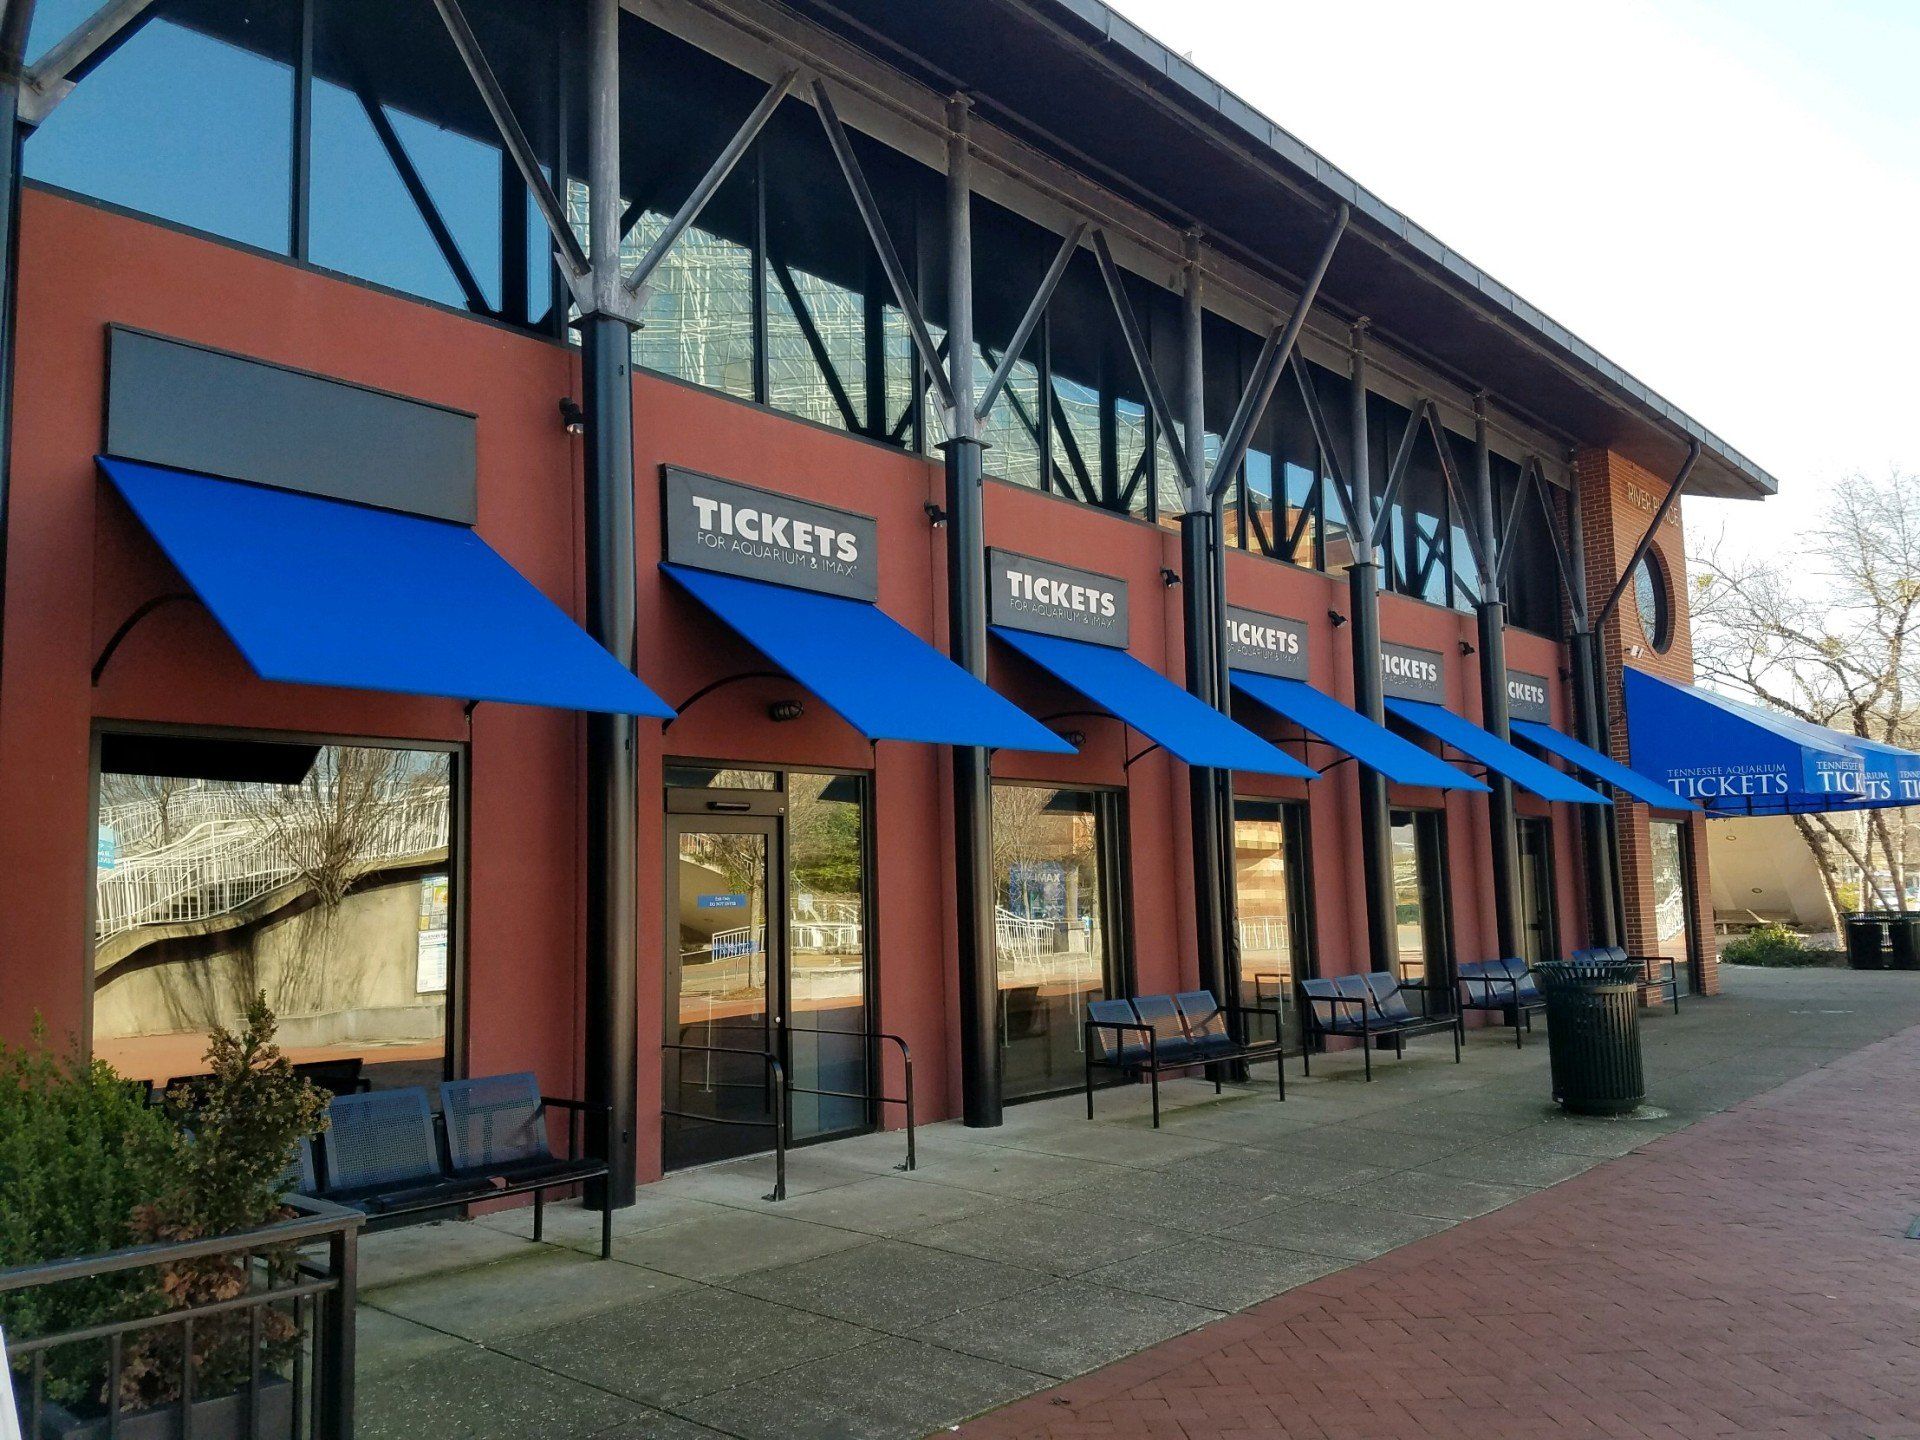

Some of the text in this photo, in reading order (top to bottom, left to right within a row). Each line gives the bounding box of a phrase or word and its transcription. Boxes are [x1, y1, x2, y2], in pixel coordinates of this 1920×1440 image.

[692, 495, 858, 562] TICKETS
[697, 531, 727, 550] FOR
[731, 540, 806, 568] AQUARIUM
[809, 557, 818, 570] &
[1006, 570, 1116, 617] TICKETS
[1010, 598, 1029, 611] FOR
[1031, 604, 1080, 622] AQUARIUM
[1380, 653, 1437, 682] ICKETS
[1507, 681, 1545, 704] CKETS
[1667, 763, 1786, 777] TENNESSEE AQUARIUM
[1668, 773, 1789, 798] TICKETS
